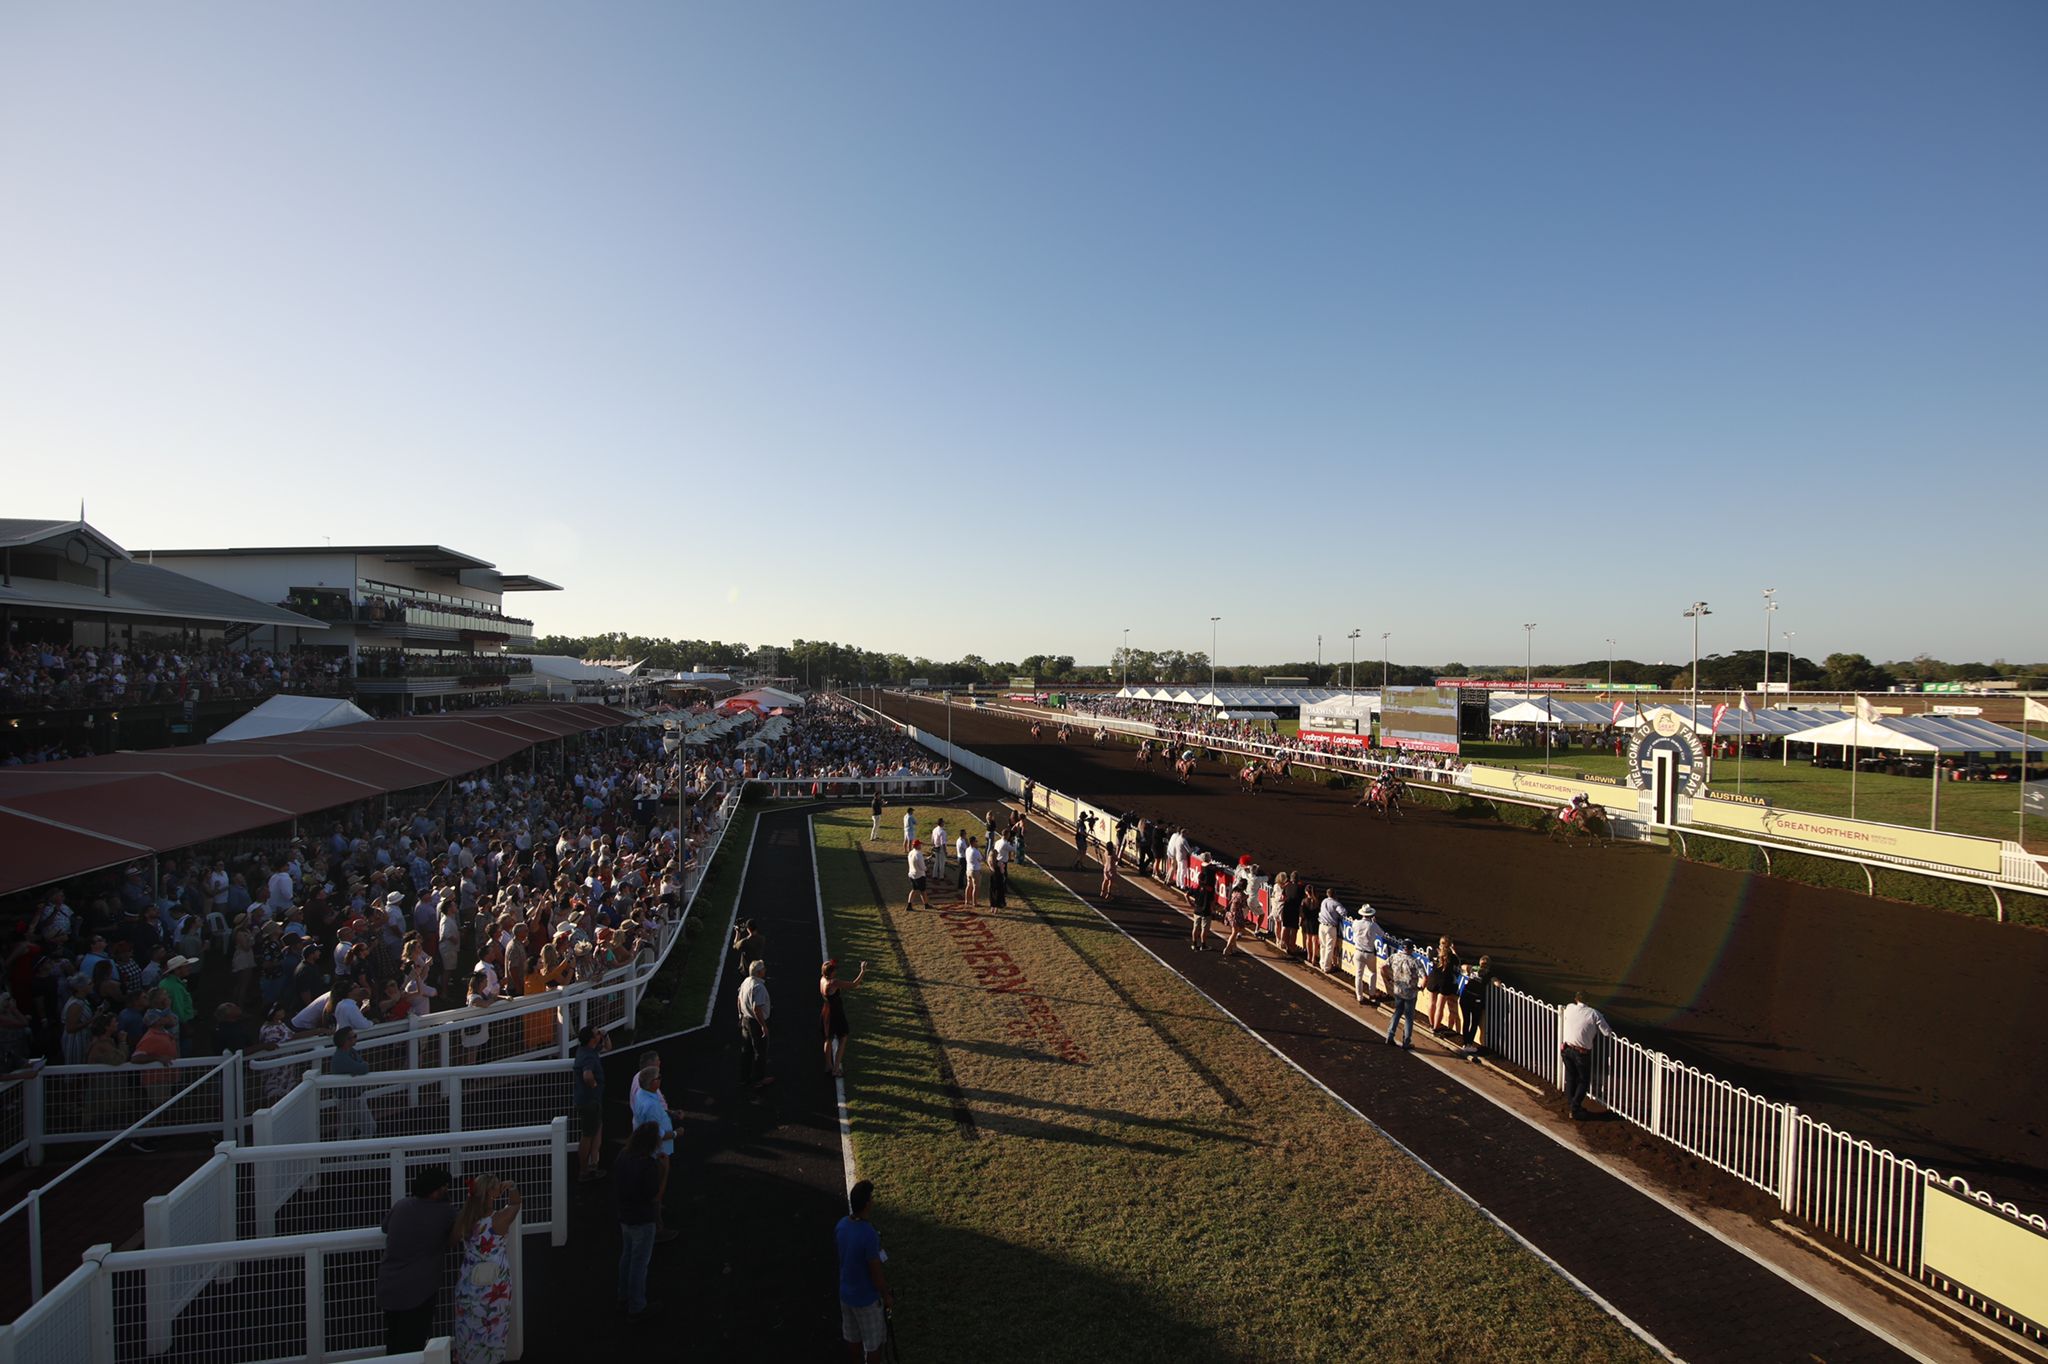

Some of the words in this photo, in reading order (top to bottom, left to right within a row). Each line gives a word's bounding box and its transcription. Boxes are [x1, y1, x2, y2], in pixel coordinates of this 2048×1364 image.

[1306, 706, 1333, 714] DARWIN
[1334, 708, 1363, 717] RACING
[1637, 725, 1651, 737] TO
[1302, 733, 1330, 742] Ladbrokes
[1333, 736, 1363, 745] Ladbrokes
[1680, 726, 1704, 768] FANNIE
[1629, 737, 1644, 788] WELCOME
[1520, 780, 1540, 788] GREAT
[1540, 783, 1572, 793] NORTHERN
[1584, 774, 1617, 785] DARWIN
[1685, 772, 1701, 795] BAY
[1709, 791, 1766, 806] AUSTRALIA
[1776, 819, 1810, 832] GREAT
[1810, 824, 1870, 842] NORTHERN
